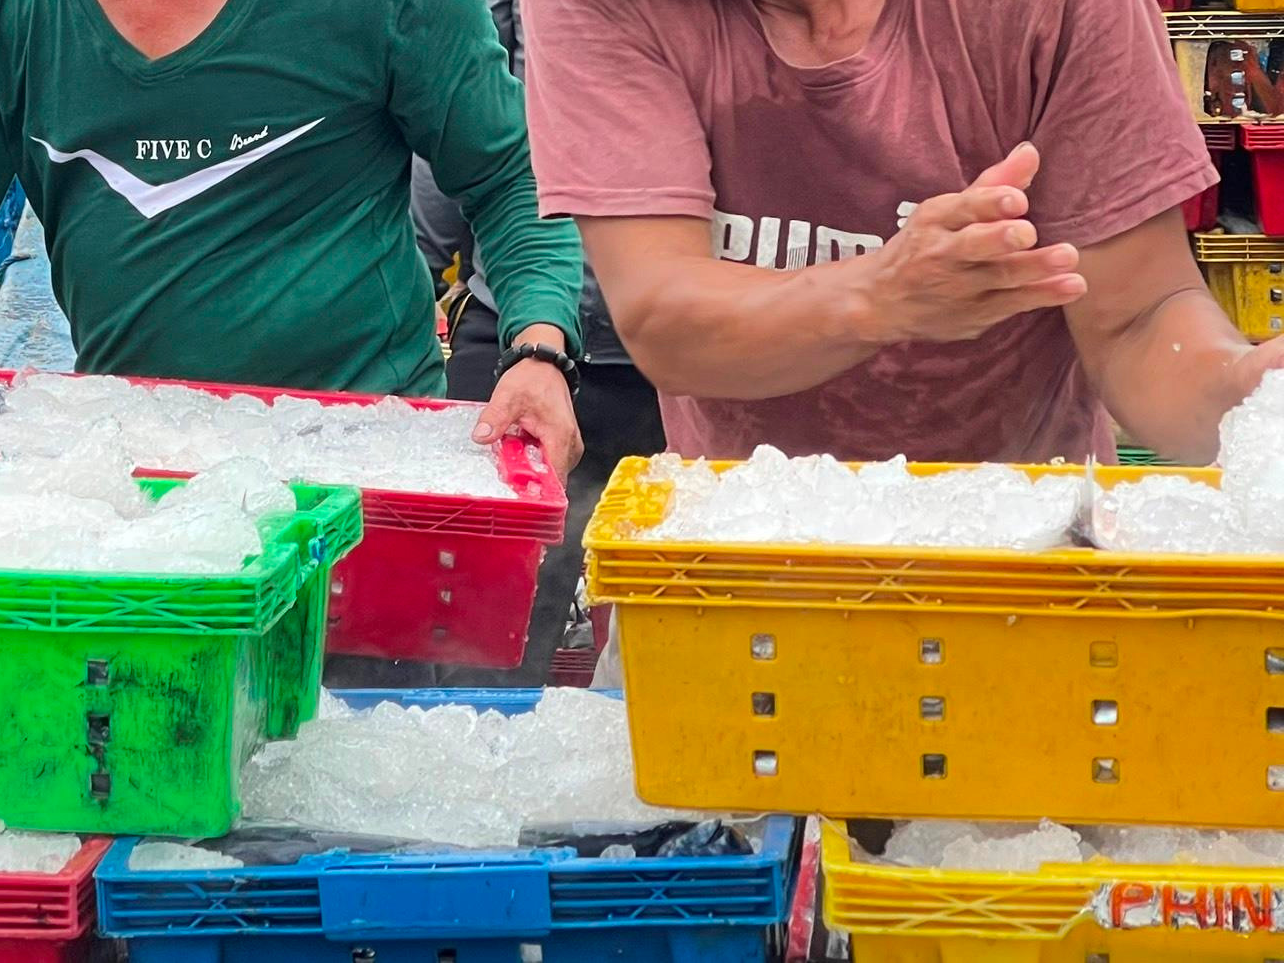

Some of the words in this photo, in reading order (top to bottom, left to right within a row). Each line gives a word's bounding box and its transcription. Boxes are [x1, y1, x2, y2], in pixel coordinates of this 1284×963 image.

[135, 139, 191, 160] FIVE
[196, 139, 212, 159] C
[712, 208, 885, 272] PUM
